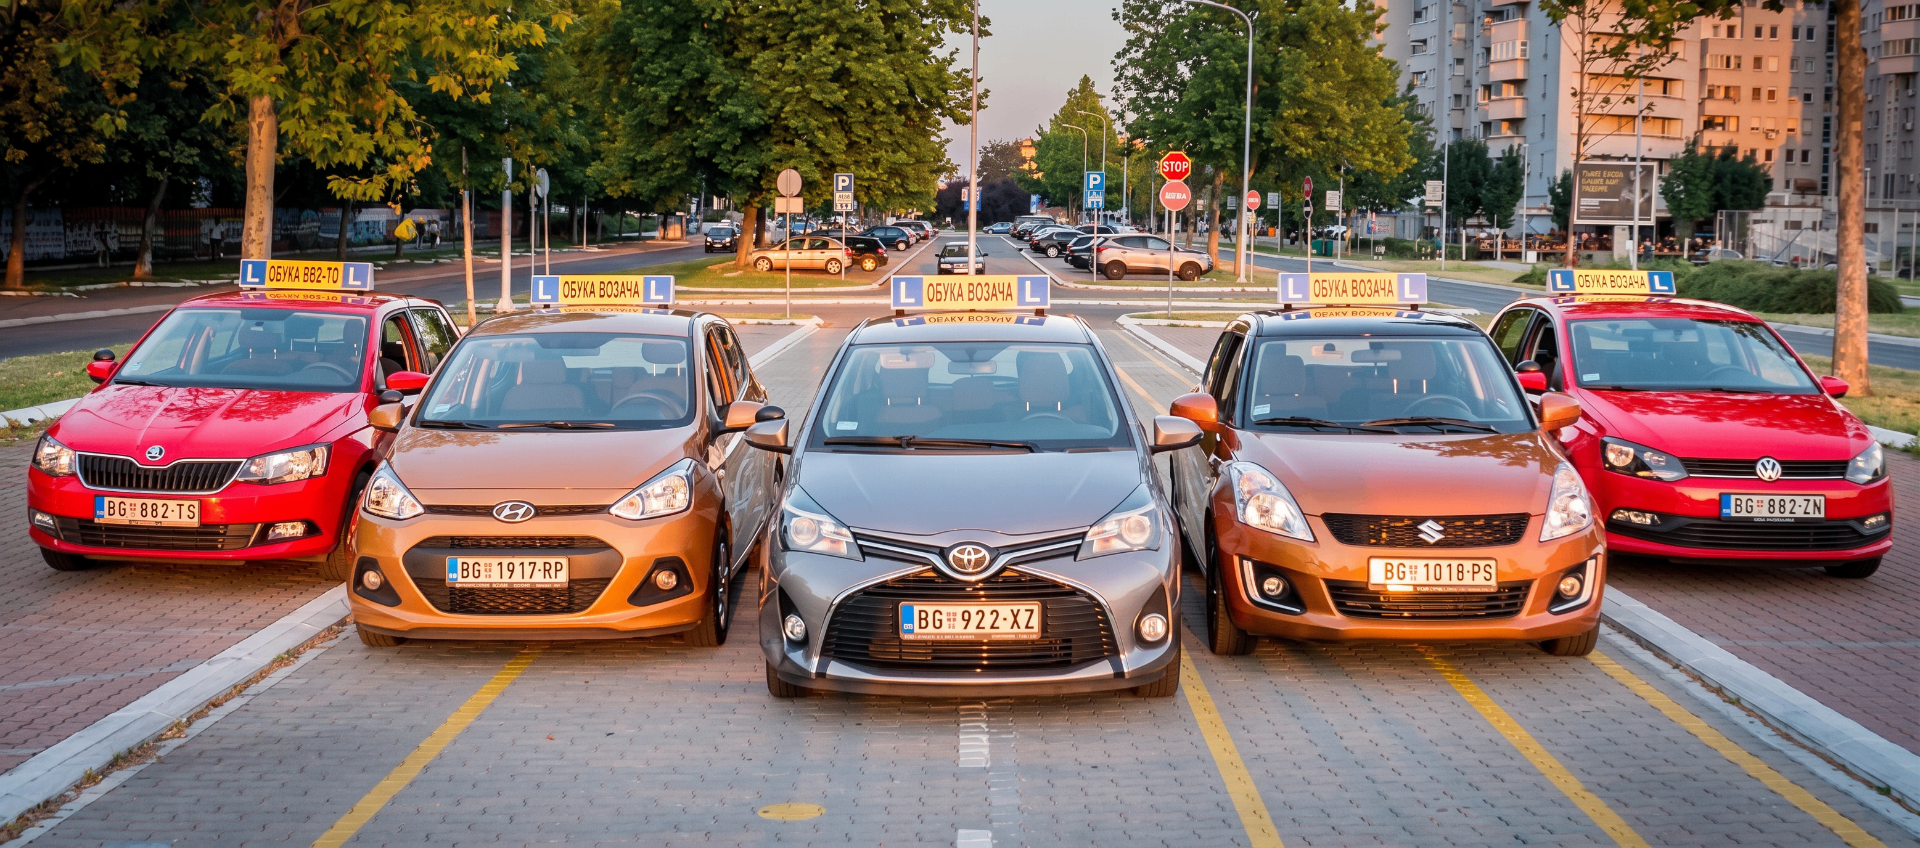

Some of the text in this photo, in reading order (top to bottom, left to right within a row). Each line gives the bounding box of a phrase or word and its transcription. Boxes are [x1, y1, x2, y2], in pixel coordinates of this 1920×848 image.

[1162, 161, 1189, 172] STOP
[838, 175, 850, 191] P
[1089, 174, 1101, 189] P
[246, 263, 260, 283] L
[268, 265, 300, 282] ОБУКА
[348, 266, 362, 286] L
[1555, 273, 1669, 290] L ОБУКА ВОЗАЧА L
[538, 279, 664, 300] L ОБУКА ВОЗАЧА L
[900, 280, 1041, 304] L ОБУКА ВОЗАЧА L
[1287, 277, 1420, 299] L ОБУКА ВОЗАЧА L
[107, 500, 127, 517] BG
[1734, 497, 1754, 514] BG
[461, 561, 482, 579] BG
[1384, 562, 1406, 581] BG
[918, 609, 943, 630] BG
